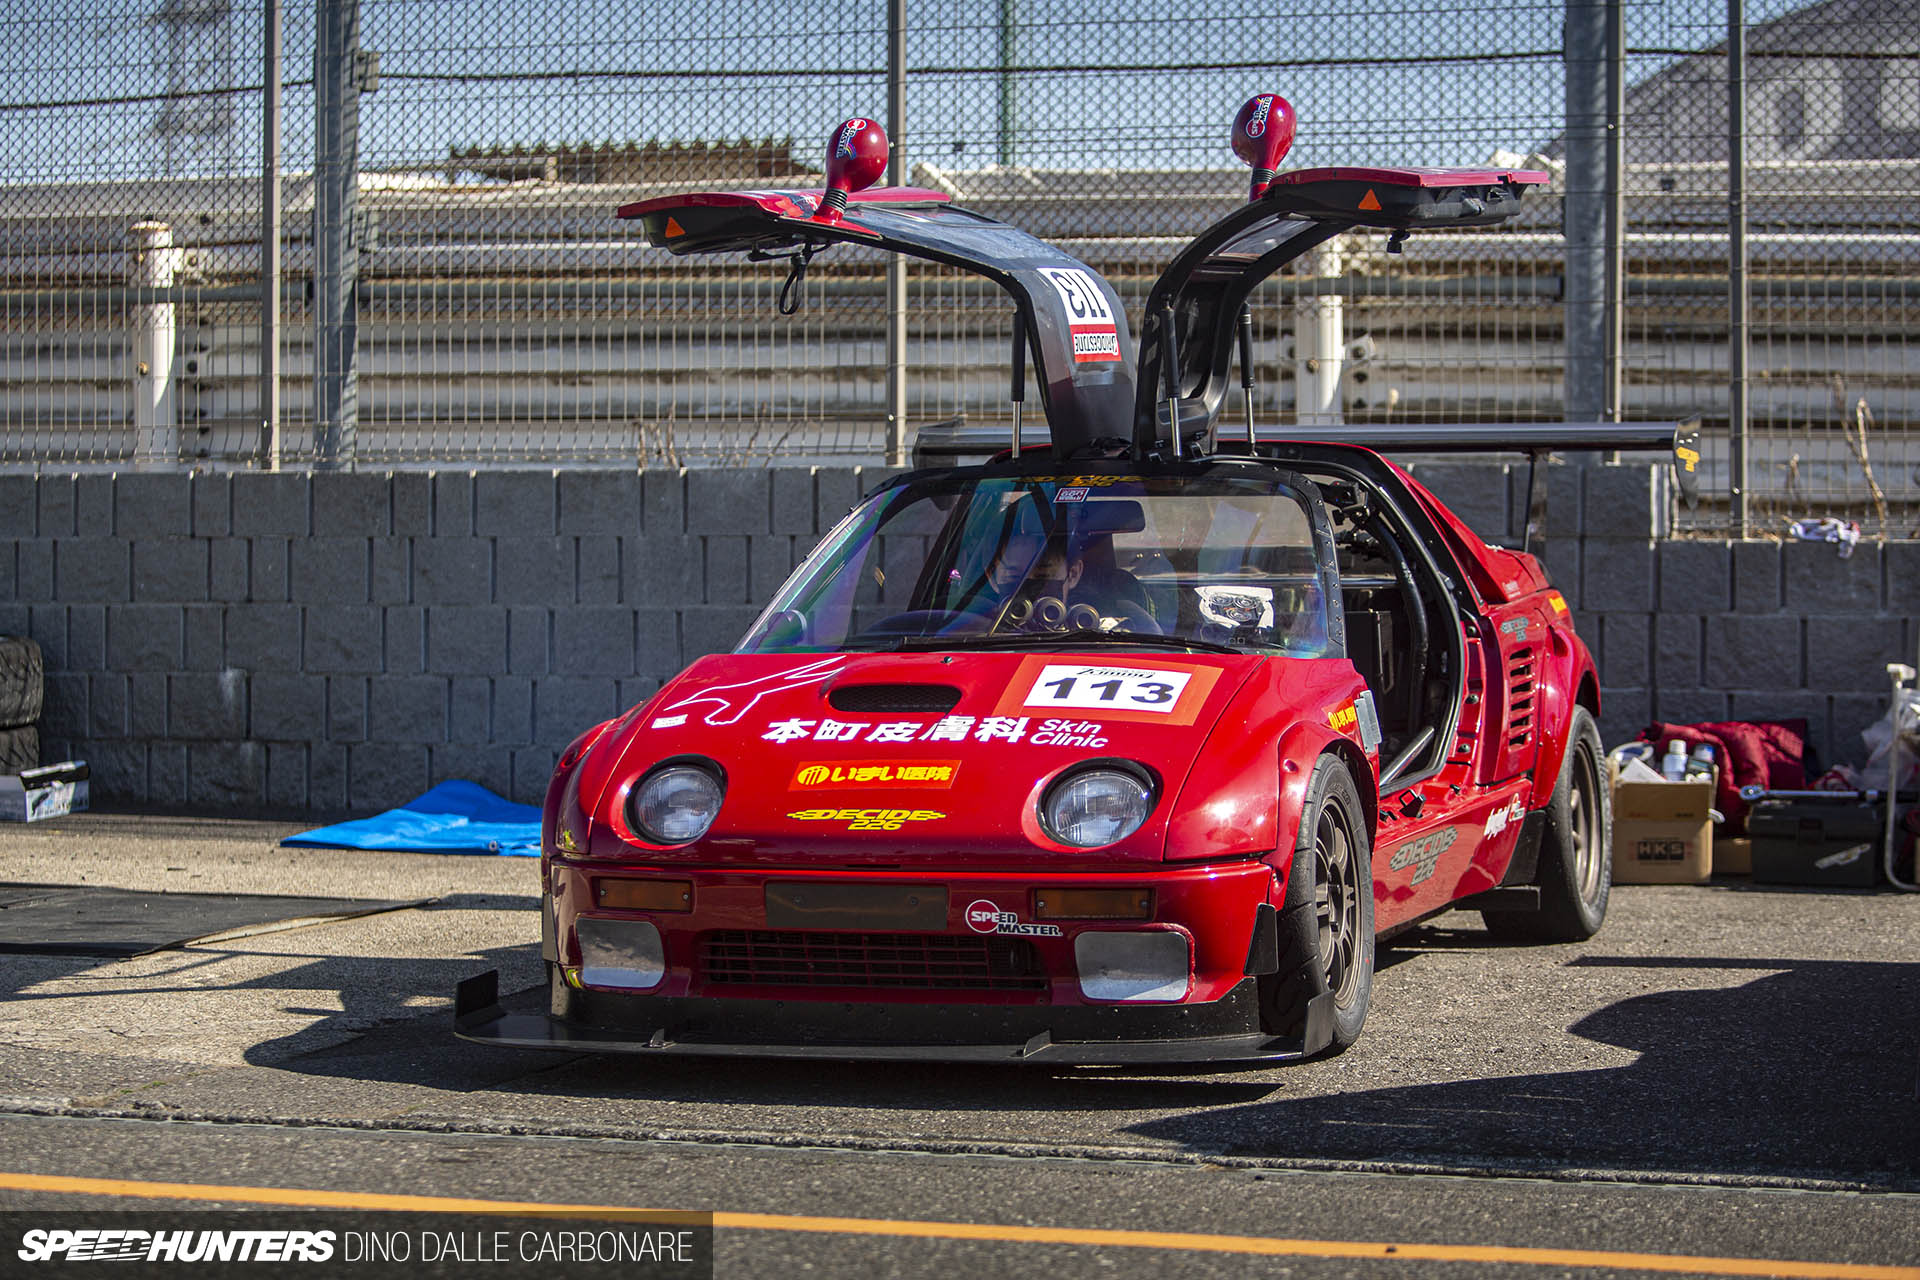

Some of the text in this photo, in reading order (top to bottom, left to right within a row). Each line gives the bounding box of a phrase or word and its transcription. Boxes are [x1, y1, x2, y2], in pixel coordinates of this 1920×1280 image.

[1050, 271, 1107, 318] 113
[1044, 677, 1175, 704] 113
[761, 716, 1031, 744] 本町皮膚科
[1038, 719, 1102, 734] Skin
[1030, 731, 1109, 748] Clinic
[831, 766, 952, 781] いまい医院
[796, 809, 938, 821] DECIDE
[848, 819, 902, 831] 226
[1391, 827, 1457, 871] DECIDE
[1638, 840, 1684, 859] HKS
[1411, 856, 1437, 886] 226
[971, 911, 1017, 922] SPEED
[998, 923, 1060, 936] MASTER
